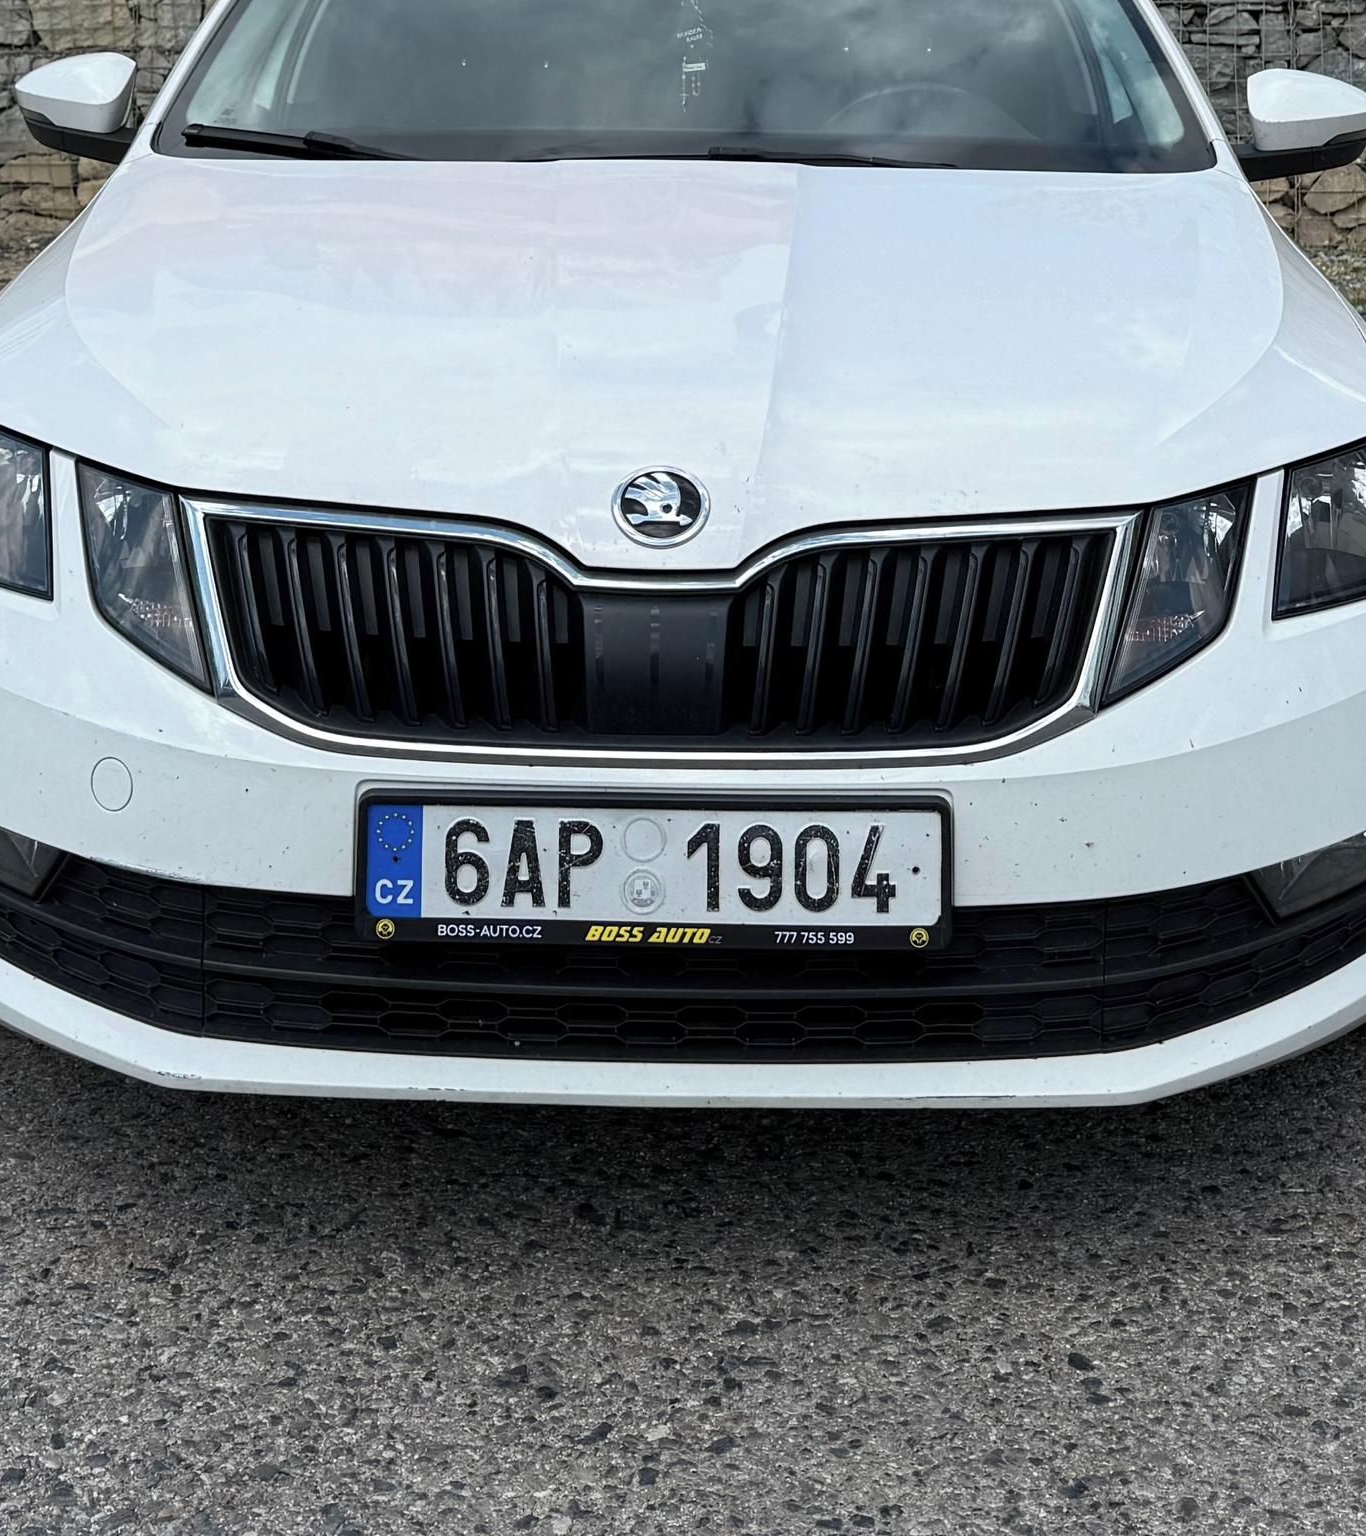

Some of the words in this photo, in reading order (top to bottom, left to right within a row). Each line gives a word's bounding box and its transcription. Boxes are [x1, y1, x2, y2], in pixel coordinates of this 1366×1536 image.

[444, 818, 604, 908] 6AP
[686, 823, 896, 914] 1904
[375, 878, 414, 904] CZ
[437, 924, 542, 938] BOSS-AUTO.CZ
[585, 925, 645, 943] BOSS
[647, 927, 712, 944] AUTO
[774, 931, 798, 944] 777
[800, 931, 826, 944] 755
[829, 932, 855, 944] 599
